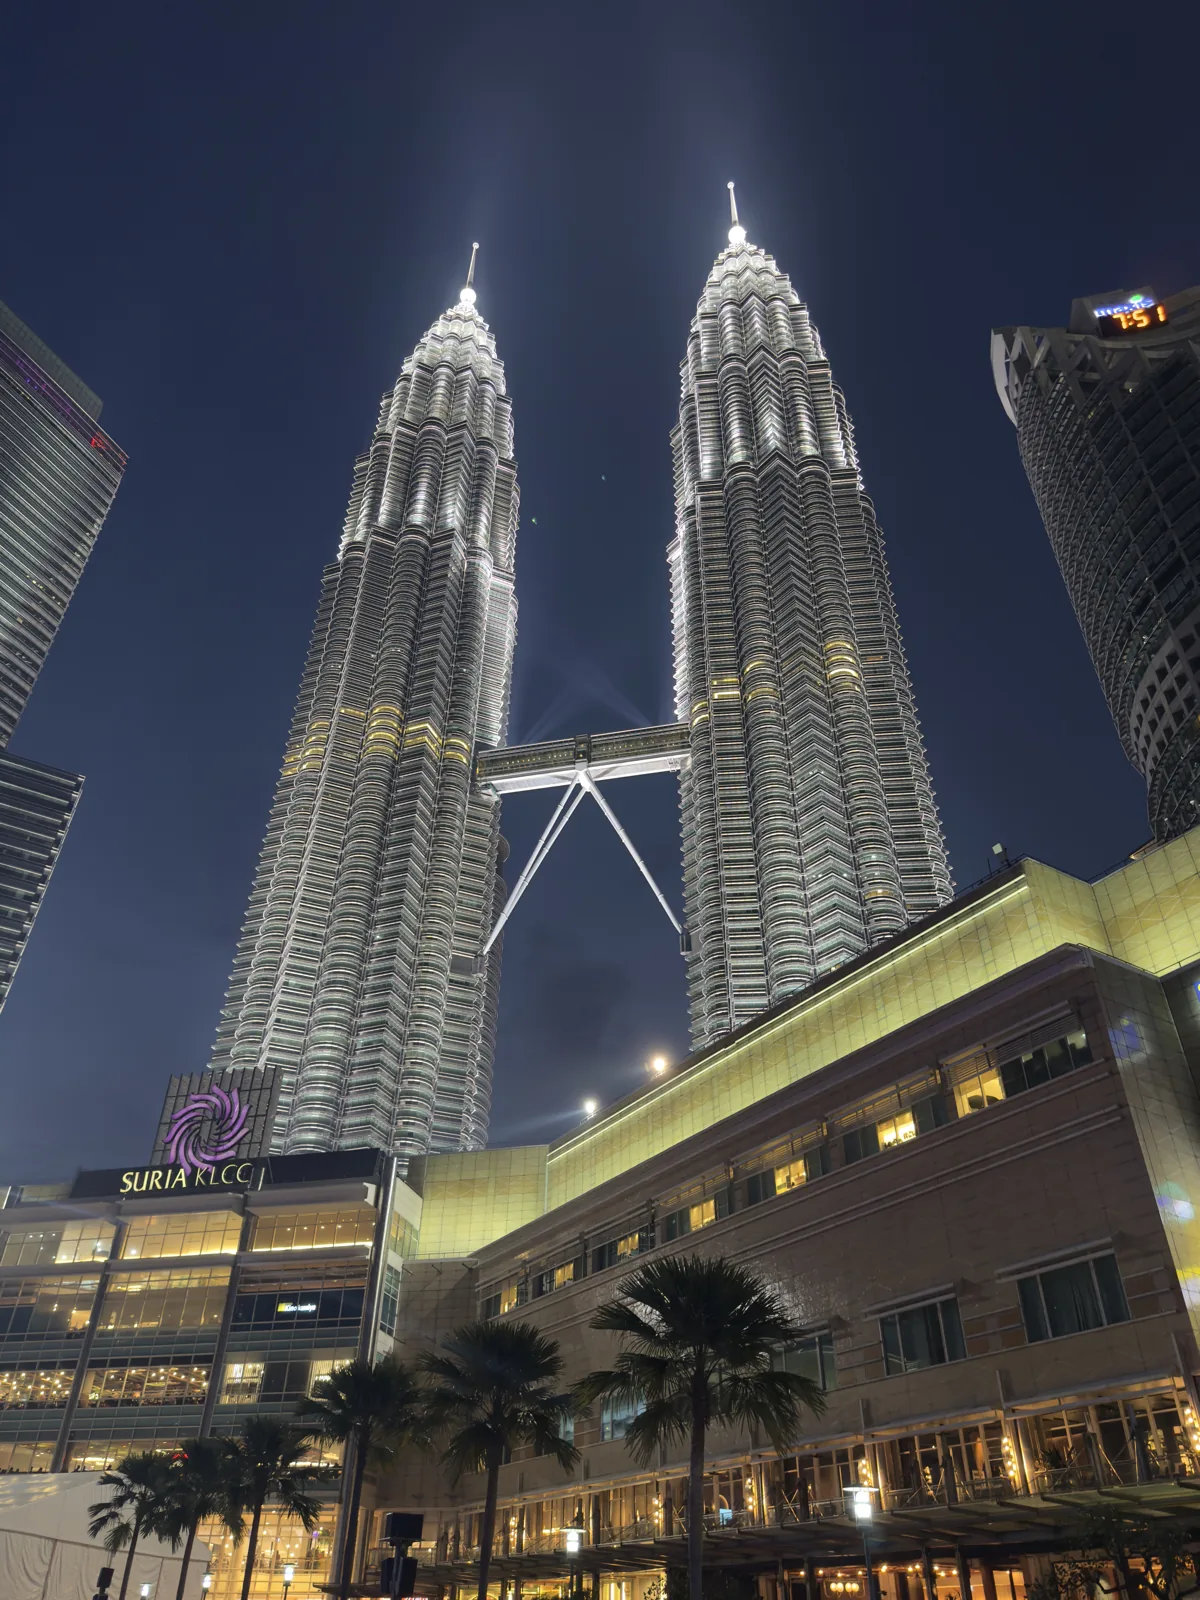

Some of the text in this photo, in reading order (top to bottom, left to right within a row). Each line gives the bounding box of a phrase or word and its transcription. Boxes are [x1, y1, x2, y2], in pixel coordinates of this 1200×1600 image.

[1112, 305, 1166, 329] 7:51
[120, 1163, 252, 1193] SURIA KLCC
